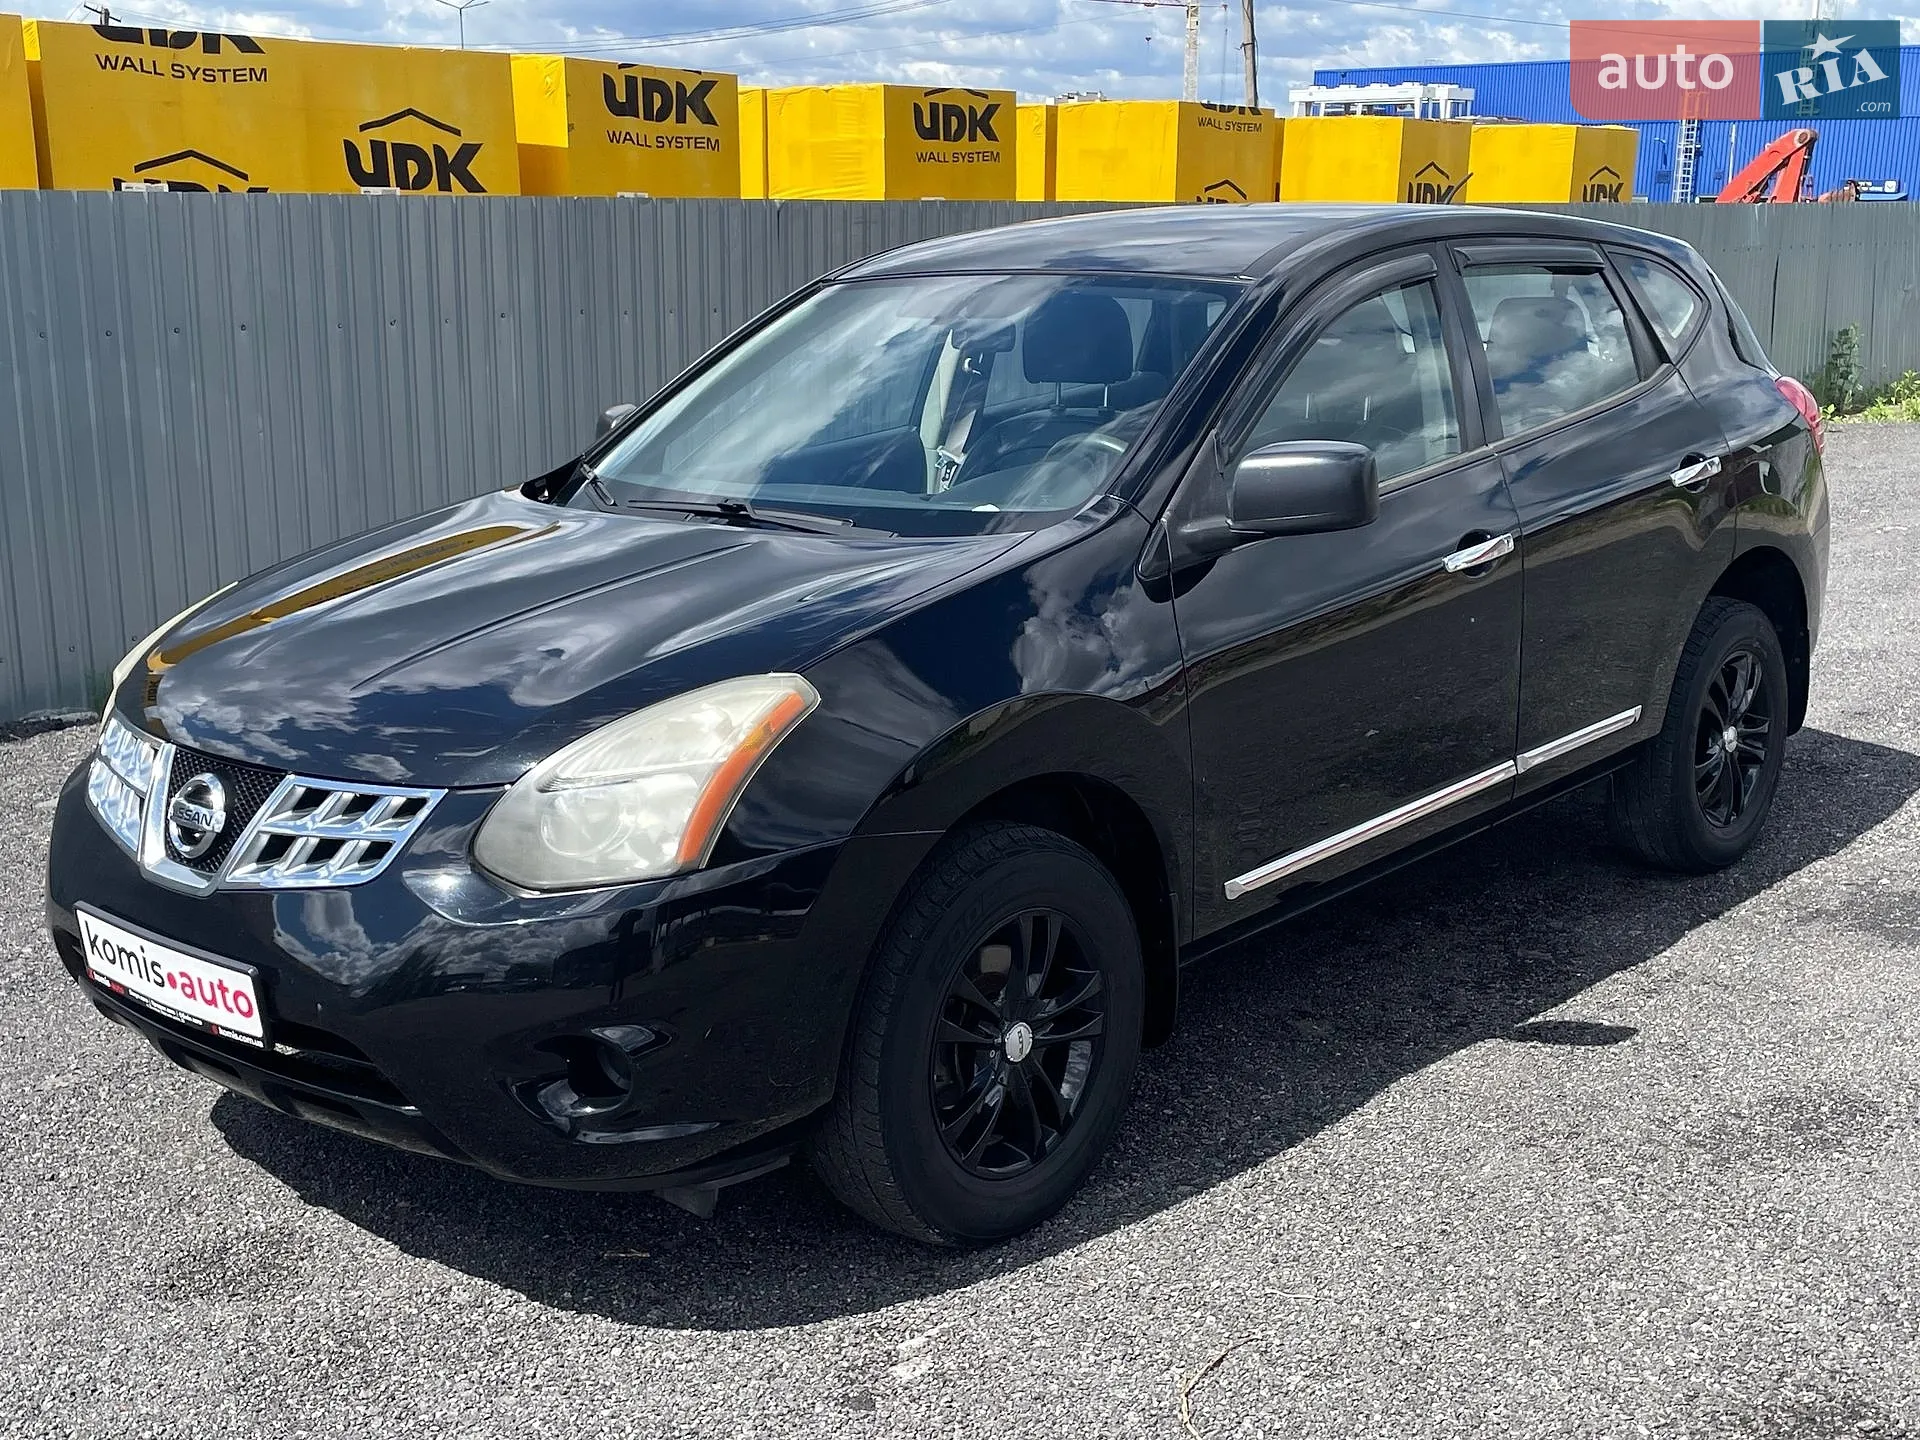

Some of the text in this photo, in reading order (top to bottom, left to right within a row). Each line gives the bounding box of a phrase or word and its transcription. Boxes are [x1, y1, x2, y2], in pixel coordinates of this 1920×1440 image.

[95, 53, 268, 83] WALL SYSTEM
[602, 73, 719, 127] UDK
[913, 102, 1001, 142] UDK
[1197, 116, 1262, 133] WALL SYSTEM
[606, 129, 721, 152] WALL SYSTEM
[343, 138, 488, 193] UDK
[916, 150, 1001, 163] WALL SYSTEM
